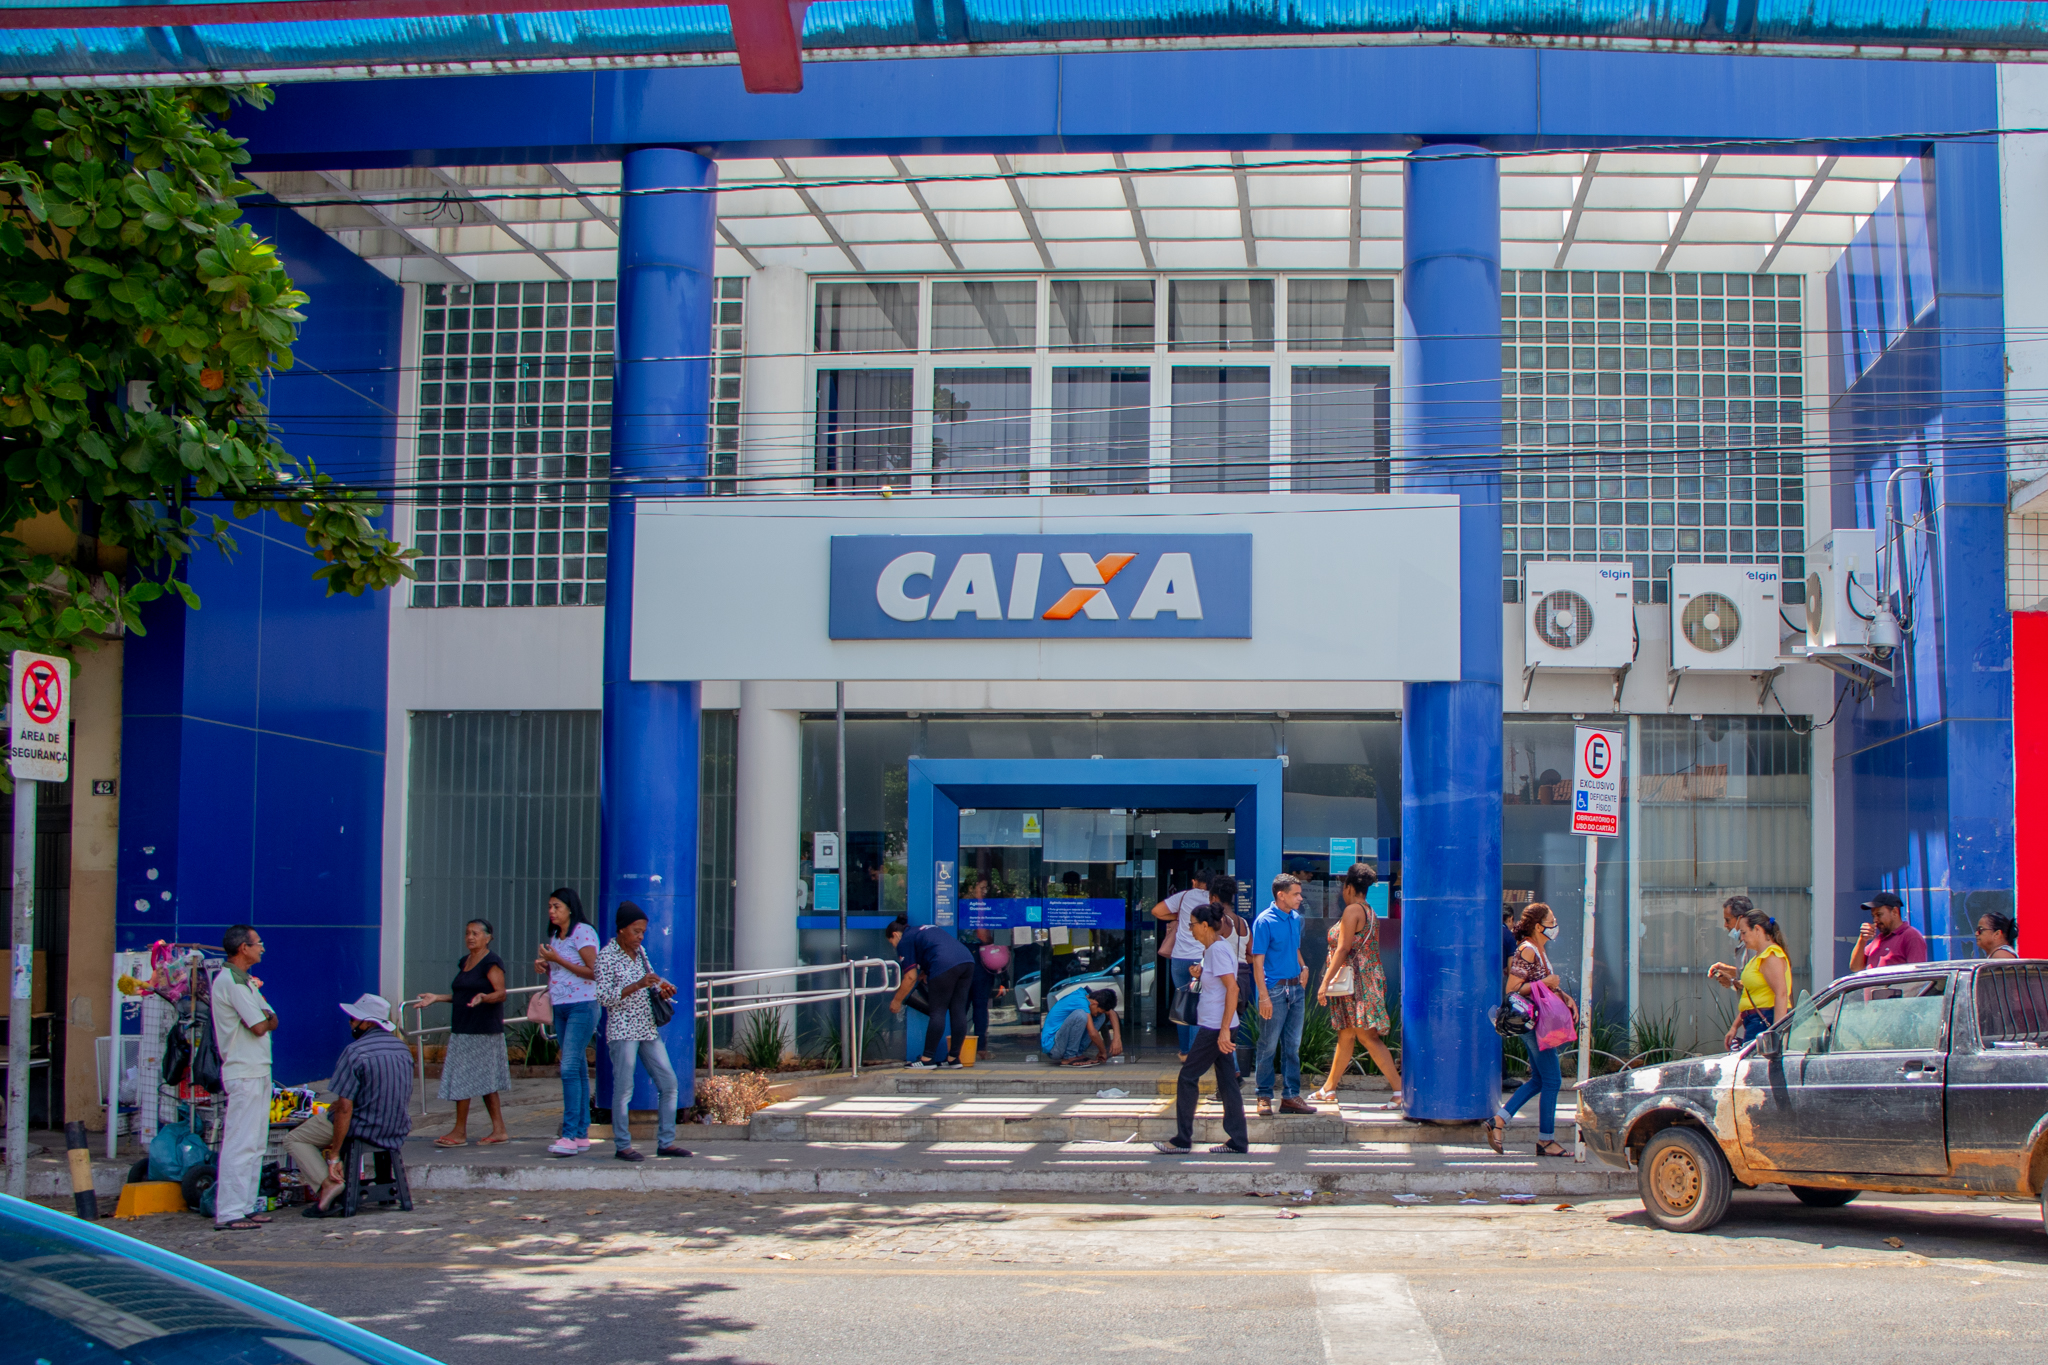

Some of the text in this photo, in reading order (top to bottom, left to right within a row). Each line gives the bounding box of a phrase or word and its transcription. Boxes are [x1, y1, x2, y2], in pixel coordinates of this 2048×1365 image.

[1600, 569, 1631, 581] elgin
[1746, 571, 1777, 583] elgin
[877, 551, 1203, 622] CAIXA
[20, 728, 60, 744] ÁREA DE
[12, 747, 69, 764] SEGURANÇA
[1592, 742, 1604, 770] E
[96, 782, 111, 794] 42
[1580, 779, 1615, 791] EXCLUSIVO
[1589, 792, 1617, 803] DEFICIENTE
[1576, 814, 1610, 824] OBRIGATÓRIO
[1575, 822, 1587, 830] USO
[1595, 824, 1615, 832] CARTÃO
